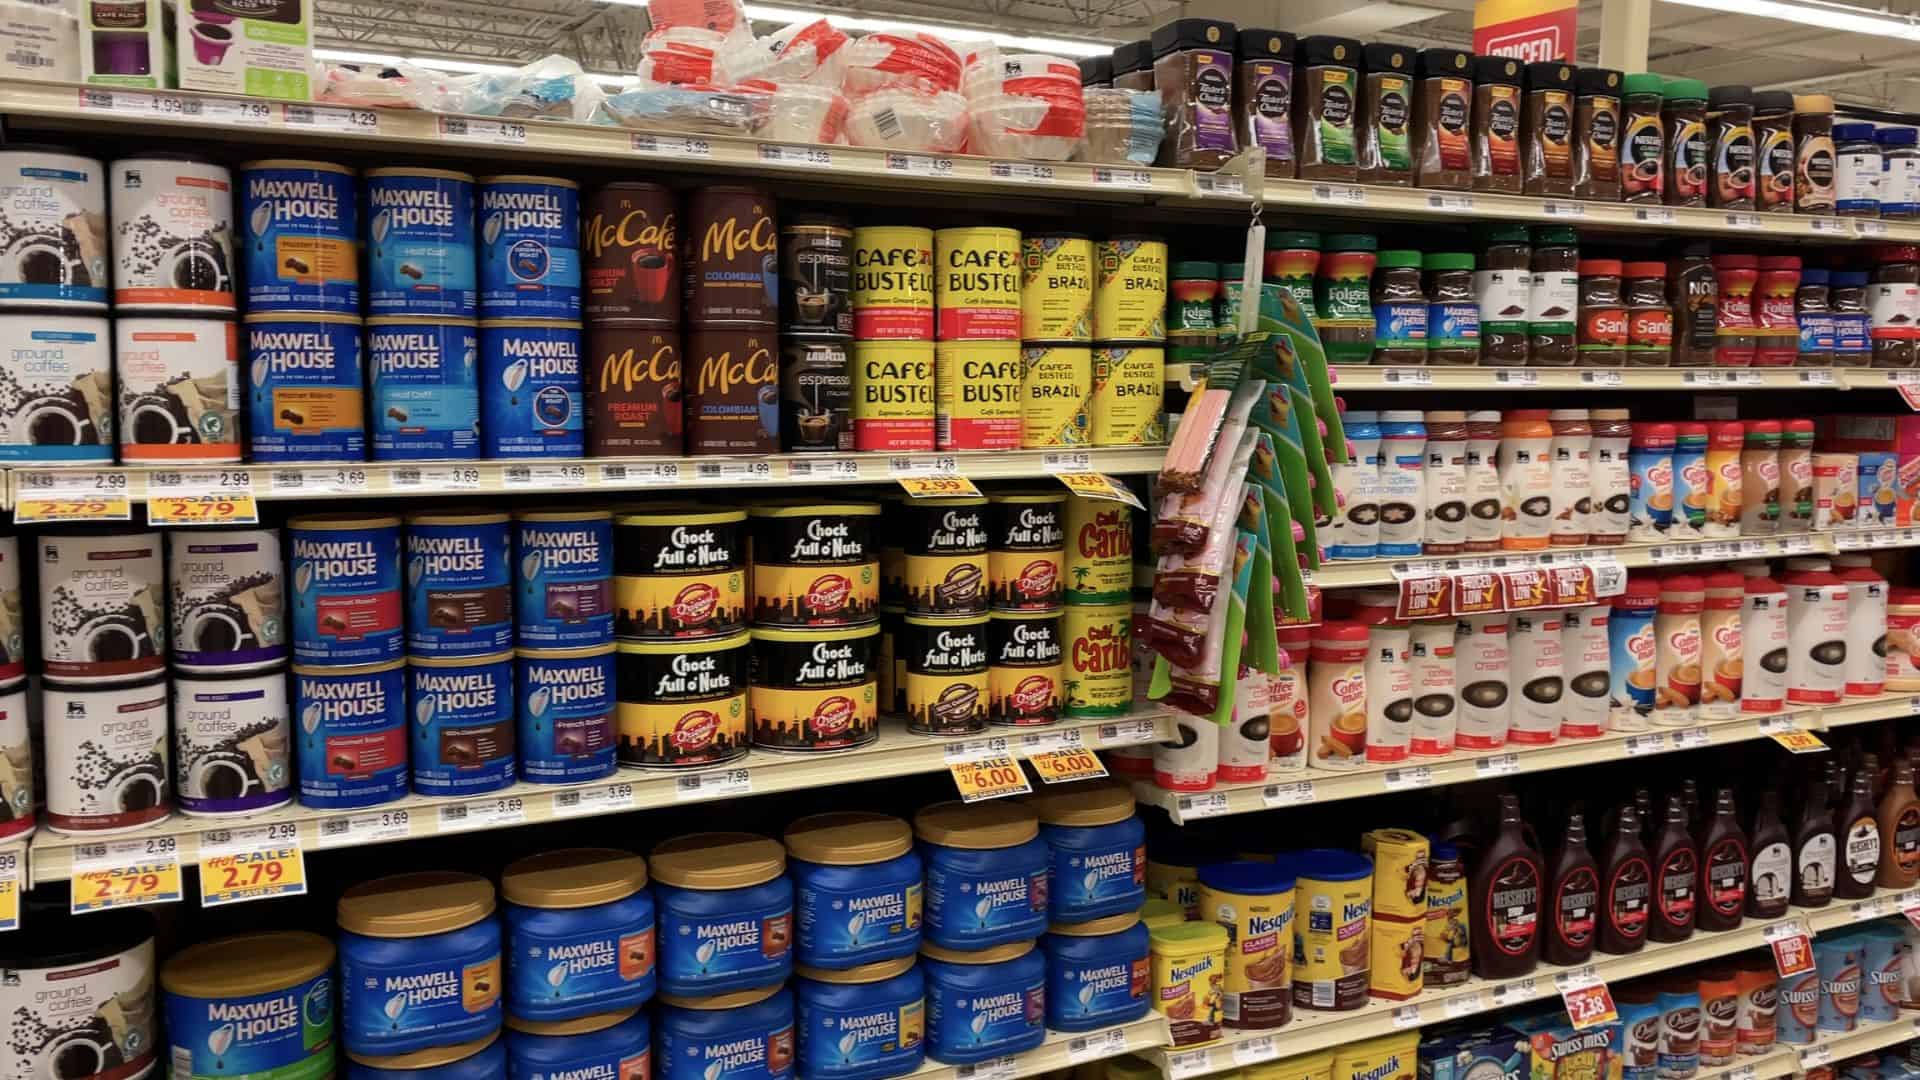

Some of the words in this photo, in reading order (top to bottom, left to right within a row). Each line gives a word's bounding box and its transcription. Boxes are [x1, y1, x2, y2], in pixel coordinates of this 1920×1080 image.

[152, 99, 182, 113] 4.99
[240, 104, 270, 118] 7.99
[349, 112, 377, 126] 4.29
[250, 178, 338, 201] MAXWELL
[371, 188, 454, 208] MAXWELL
[275, 200, 339, 221] HOUSE
[483, 191, 563, 211] MAXWELL
[393, 208, 454, 229] HOUSE
[504, 210, 563, 231] HOUSE
[250, 331, 334, 351] MAXWELL
[503, 338, 578, 358] MAXWELL
[272, 351, 335, 372] HOUSE
[530, 358, 579, 378] HOUSE
[1032, 383, 1080, 398] BRAZIL
[1117, 382, 1161, 398] BRAZIL
[337, 471, 365, 484] 3.69
[453, 469, 479, 483] 3.69
[560, 466, 585, 480] 3.69
[654, 464, 678, 476] 4.99
[747, 462, 769, 474] 4.99
[96, 474, 126, 488] 2.99
[220, 472, 249, 486] 2.99
[920, 480, 962, 491] 2.99
[40, 502, 106, 515] 2.79
[172, 502, 235, 517] 2.79
[1020, 508, 1055, 525] Chock
[943, 510, 979, 528] Chock
[521, 529, 599, 549] MAXWELL
[671, 527, 715, 549] Chock
[808, 519, 848, 541] Chock
[927, 528, 955, 549] full
[1006, 526, 1033, 545] full
[294, 540, 377, 560] MAXWELL
[406, 536, 484, 556] MAXWELL
[790, 538, 820, 559] full
[822, 537, 862, 558] o'Nuts
[314, 554, 377, 581] HOUSE
[426, 553, 485, 577] HOUSE
[544, 549, 600, 571] HOUSE
[654, 547, 685, 573] full
[687, 546, 729, 567] o'Nuts
[72, 565, 123, 585] ground
[85, 578, 129, 591] coffee
[190, 570, 230, 584] coffee
[1014, 625, 1051, 644] Chock
[813, 641, 852, 664] Chock
[1000, 640, 1027, 660] full
[529, 664, 605, 684] MAXWELL
[672, 653, 716, 676] Chock
[796, 662, 826, 682] full
[828, 660, 864, 679] o'Nuts
[302, 680, 385, 702] MAXWELL
[552, 681, 605, 705] HOUSE
[655, 674, 685, 696] full
[687, 673, 730, 692] o'Nuts
[186, 708, 231, 726] ground
[324, 697, 385, 721] HOUSE
[198, 718, 237, 732] coffee
[974, 758, 1013, 776] SALE!
[608, 785, 632, 799] 3.69
[497, 799, 523, 813] 3.69
[382, 811, 408, 827] 3.69
[268, 824, 297, 839] 2.99
[146, 838, 175, 853] 2.99
[238, 848, 296, 866] SALE!
[1085, 851, 1131, 869] MAXWELL
[112, 862, 174, 878] SALE!
[224, 863, 283, 888] 2.79
[1099, 861, 1132, 877] HOUSE
[96, 874, 159, 898] 2.79
[976, 877, 1027, 896] MAXWELL
[848, 892, 902, 912] MAXWELL
[992, 889, 1027, 907] HOUSE
[866, 905, 903, 925] HOUSE
[697, 920, 759, 940] MAXWELL
[548, 940, 614, 961] MAXWELL
[717, 932, 759, 952] HOUSE
[570, 954, 615, 974] HOUSE
[1171, 958, 1213, 983] Nesquik
[384, 971, 458, 992] MAXWELL
[35, 982, 87, 1005] ground
[408, 986, 459, 1007] HOUSE
[208, 995, 298, 1022] MAXWELL
[236, 1010, 298, 1042] HOUSE
